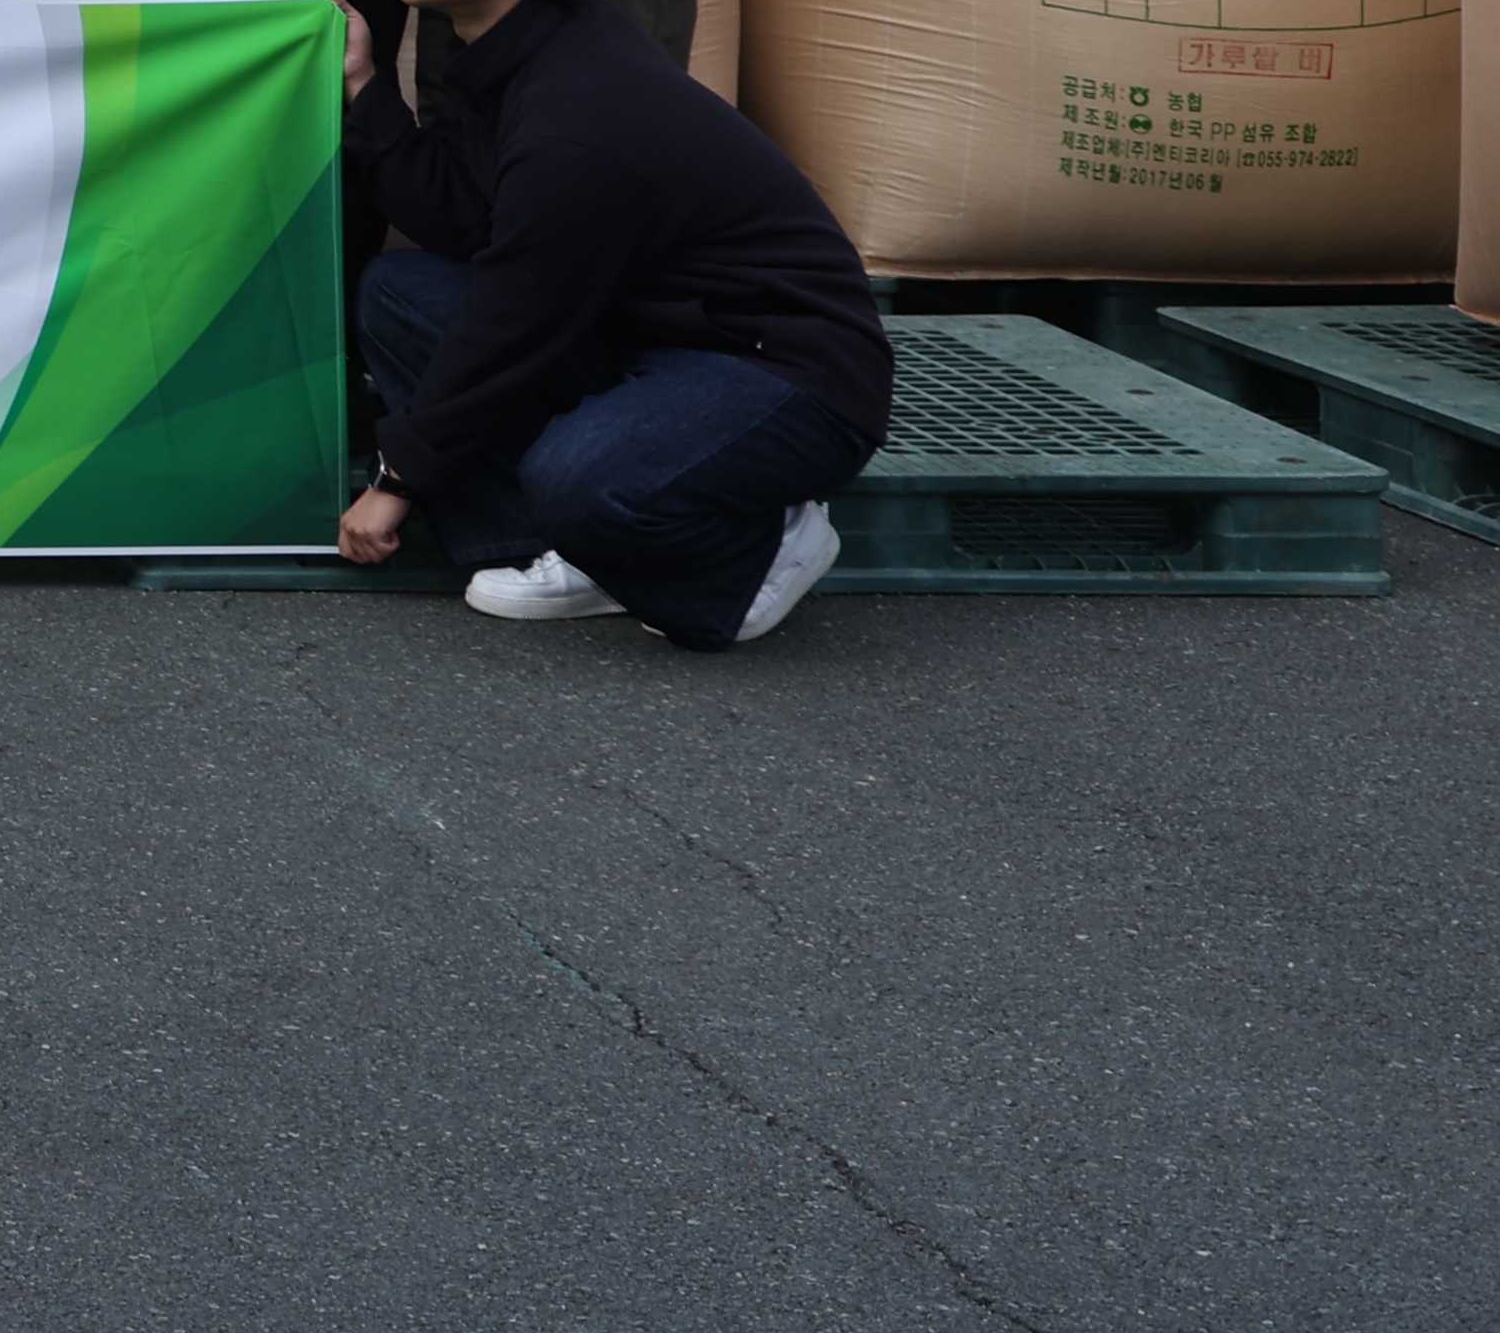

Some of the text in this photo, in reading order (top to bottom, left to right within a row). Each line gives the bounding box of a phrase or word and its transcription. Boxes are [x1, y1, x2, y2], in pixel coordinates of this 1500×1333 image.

[1167, 90, 1203, 113] 농협
[1169, 118, 1203, 140] 한국
[1211, 122, 1236, 141] PP
[1242, 123, 1275, 144] 섬유
[1284, 122, 1317, 144] 조합
